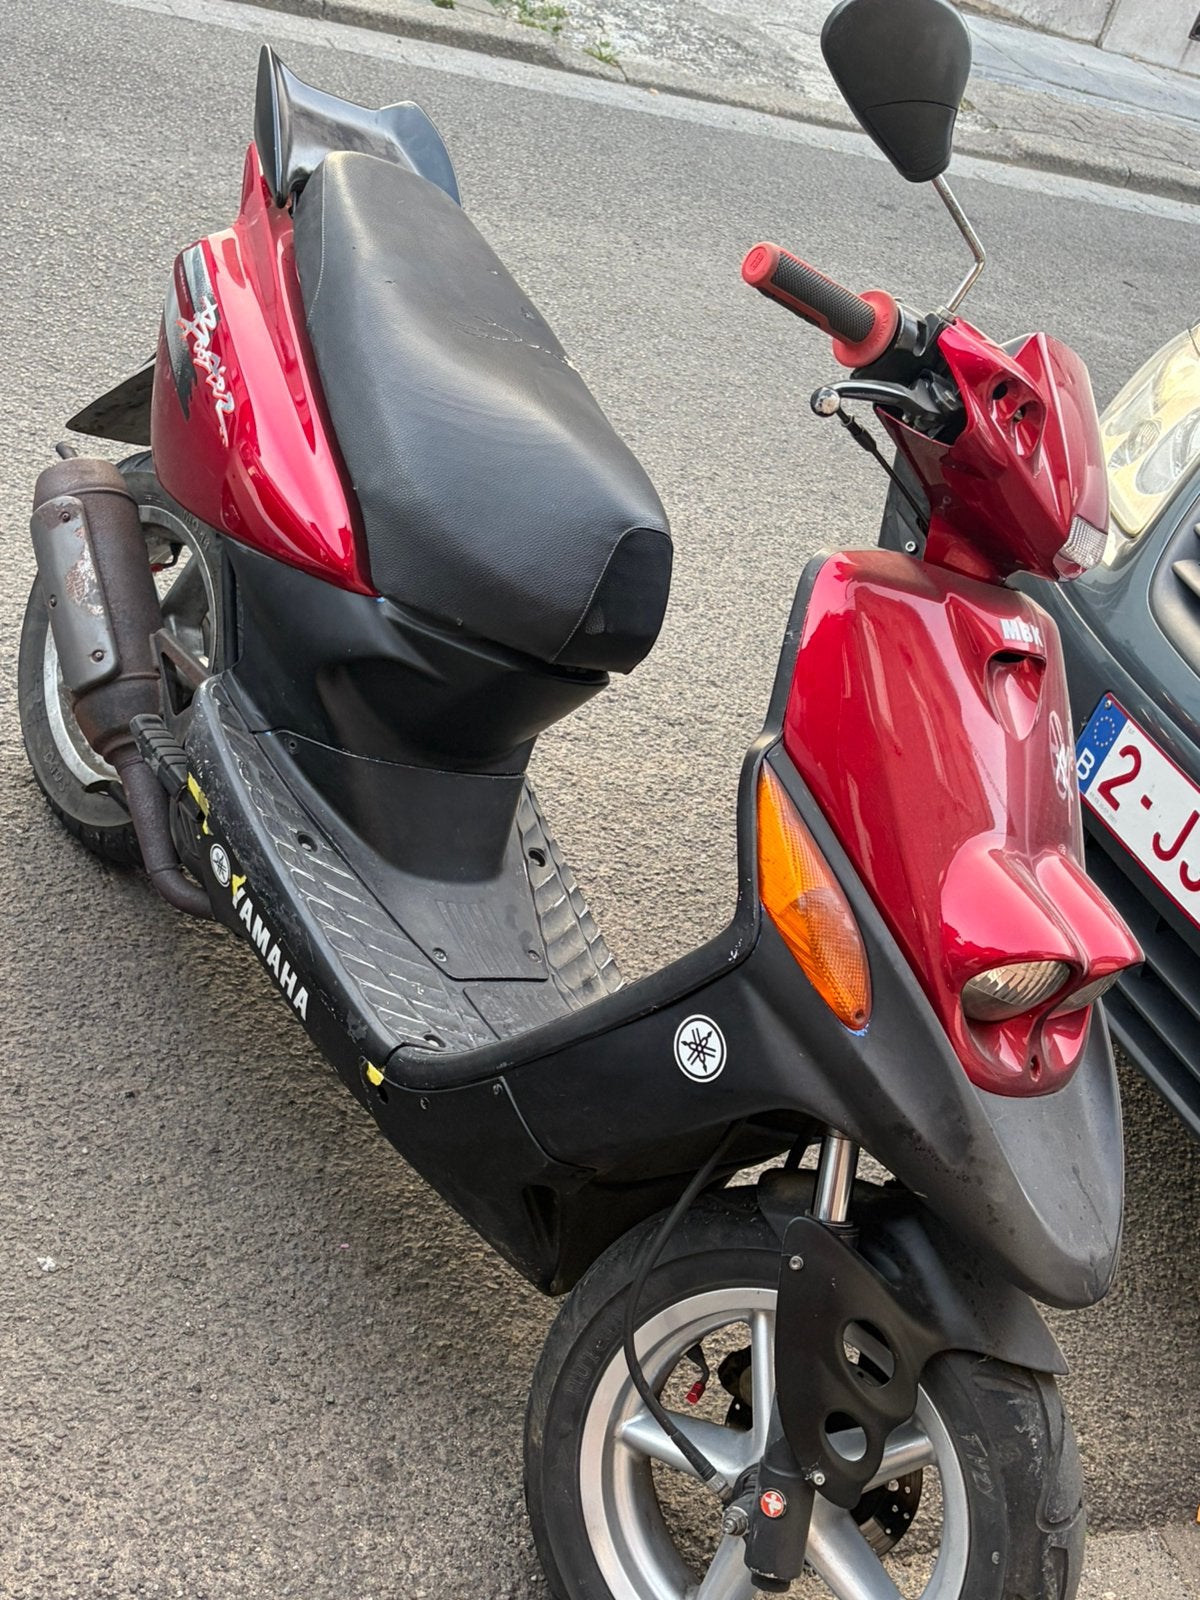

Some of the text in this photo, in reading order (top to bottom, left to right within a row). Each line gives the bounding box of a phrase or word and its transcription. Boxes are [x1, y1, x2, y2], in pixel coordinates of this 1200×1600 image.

[1000, 616, 1044, 648] MBK
[1076, 747, 1095, 781] B
[231, 878, 309, 1021] YAMAHA
